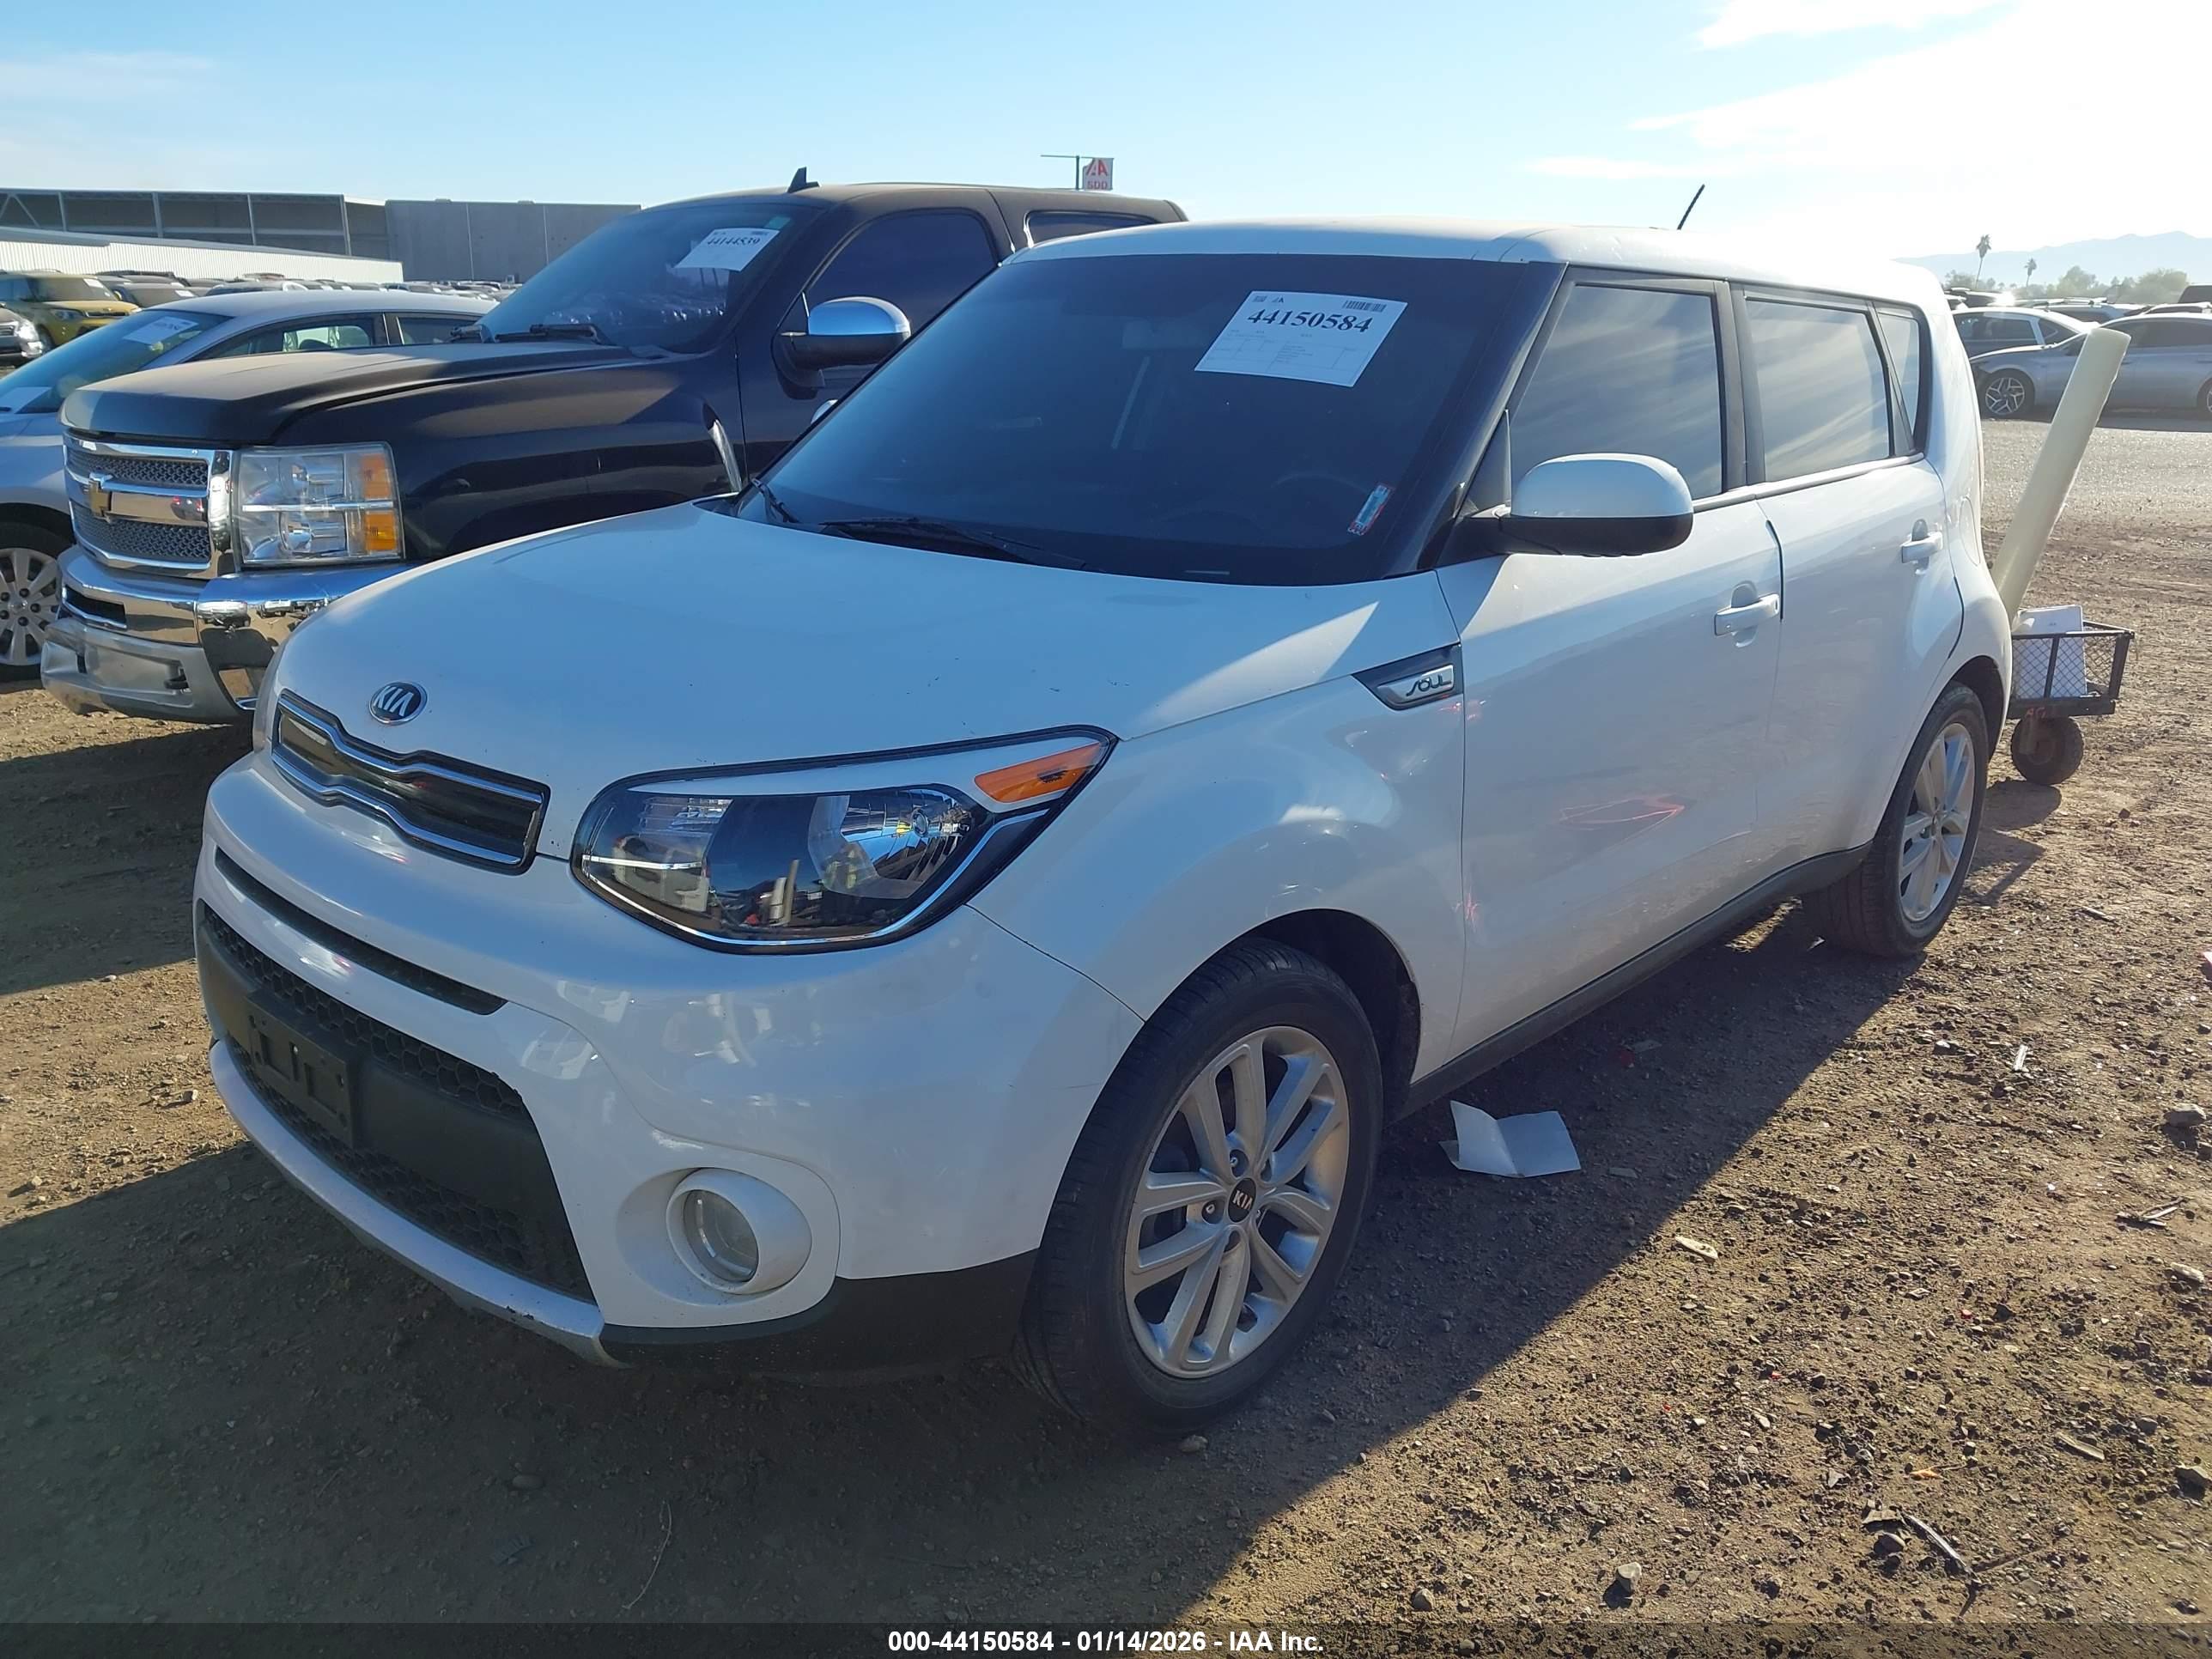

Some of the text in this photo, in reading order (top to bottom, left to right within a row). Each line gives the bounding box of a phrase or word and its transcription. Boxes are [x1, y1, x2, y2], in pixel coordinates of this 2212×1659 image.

[1247, 308, 1374, 333] 44150584
[373, 685, 414, 717] KIA
[1232, 1189, 1253, 1209] KIA
